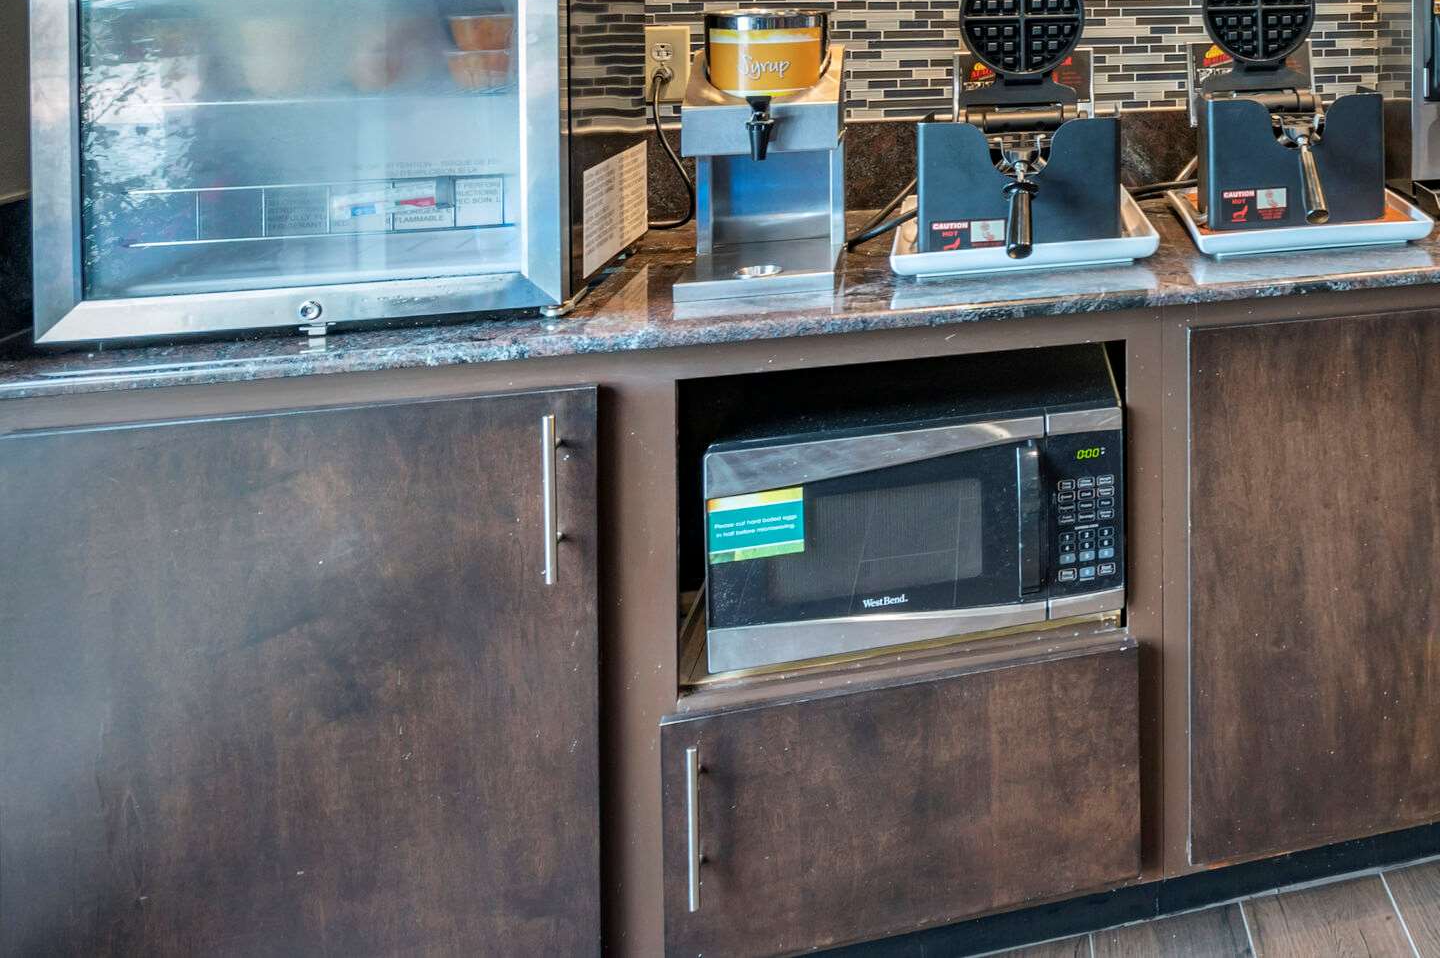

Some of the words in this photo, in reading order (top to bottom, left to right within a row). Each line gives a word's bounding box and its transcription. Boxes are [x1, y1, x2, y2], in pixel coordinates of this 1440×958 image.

[739, 54, 791, 80] Syrup
[1223, 190, 1255, 199] CAUTION
[932, 222, 968, 230] CAUTION
[863, 598, 883, 608] West
